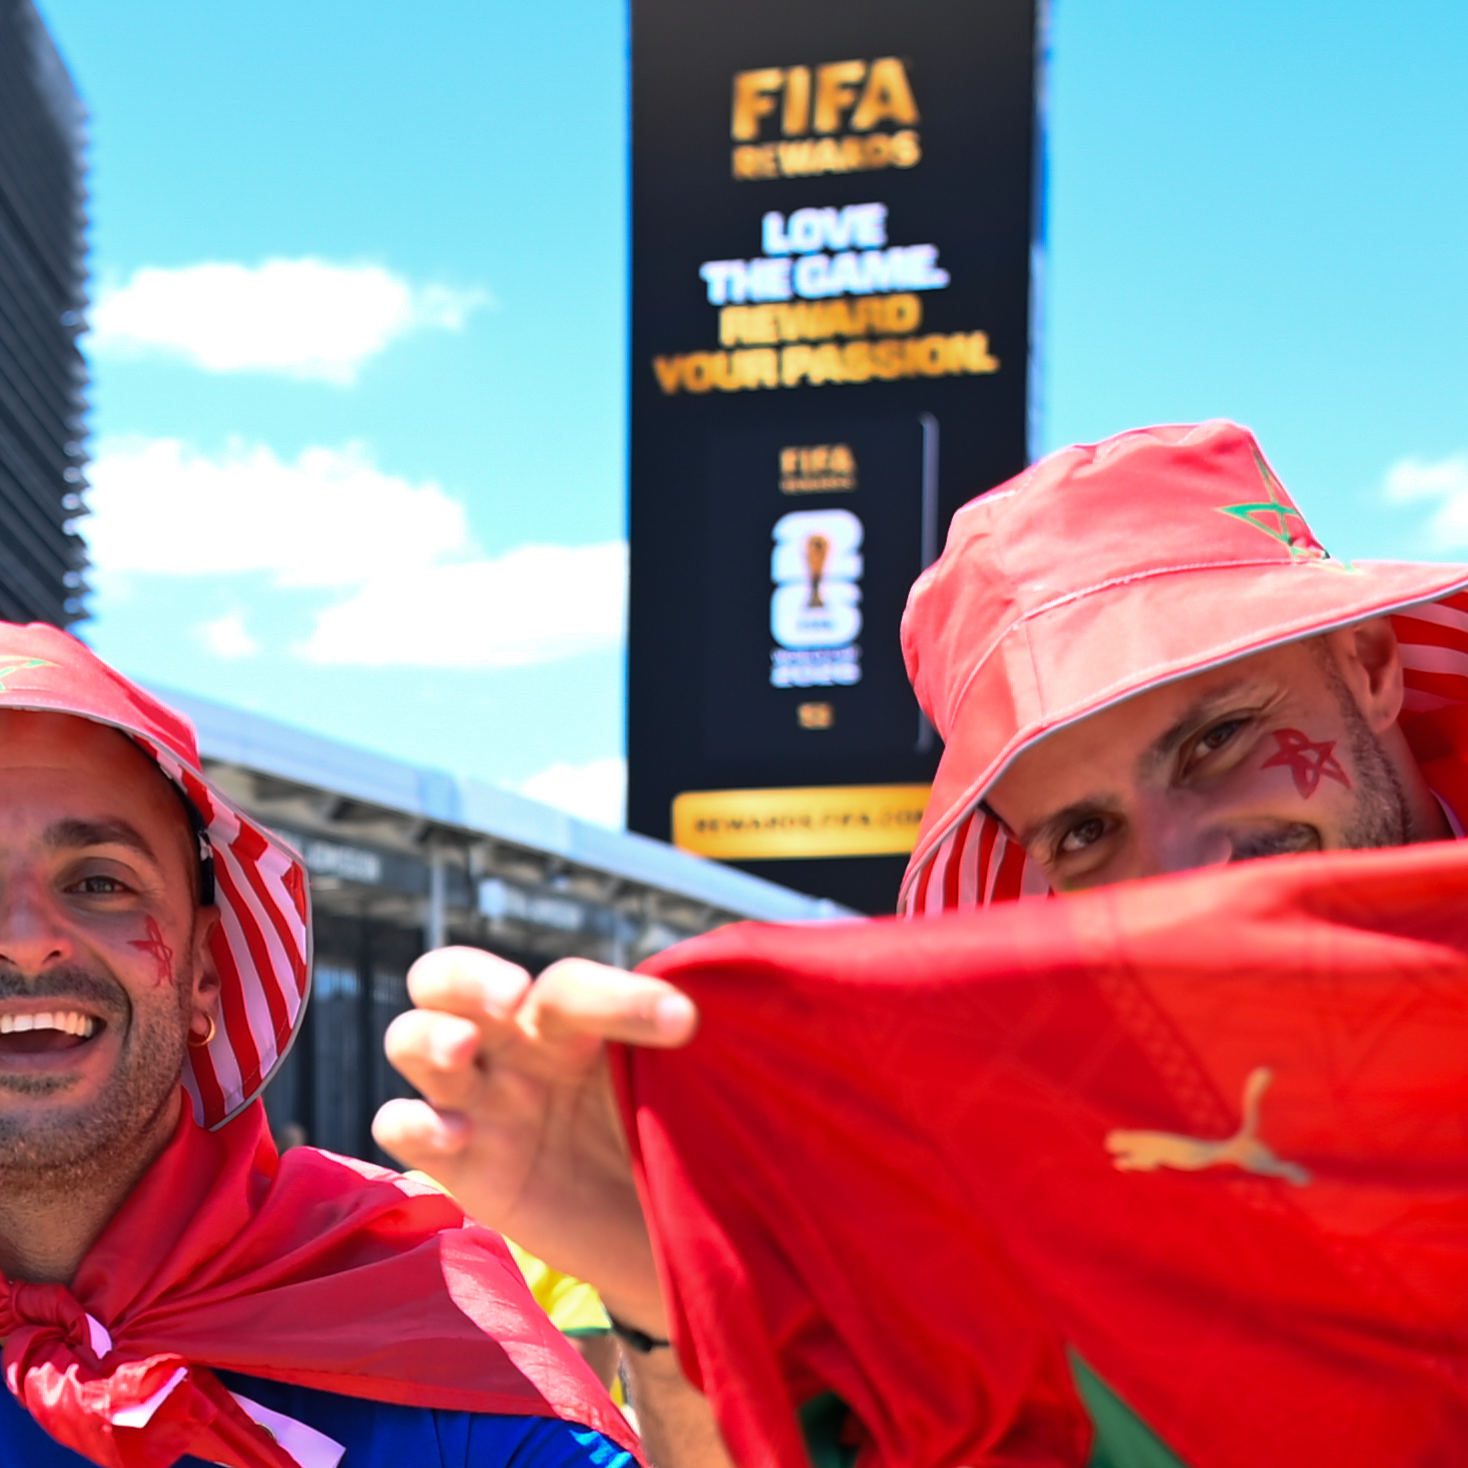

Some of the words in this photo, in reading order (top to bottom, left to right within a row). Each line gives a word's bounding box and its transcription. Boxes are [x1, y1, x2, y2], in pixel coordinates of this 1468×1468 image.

[732, 56, 919, 141] FIFA
[732, 131, 921, 178] REWARDS
[763, 203, 888, 256] LOVE
[700, 261, 793, 305] THE
[794, 245, 949, 298] GAME.
[719, 294, 921, 346] REWARD
[653, 348, 778, 394] YOUR
[781, 331, 999, 387] PASSION.
[779, 443, 857, 474] FIFA
